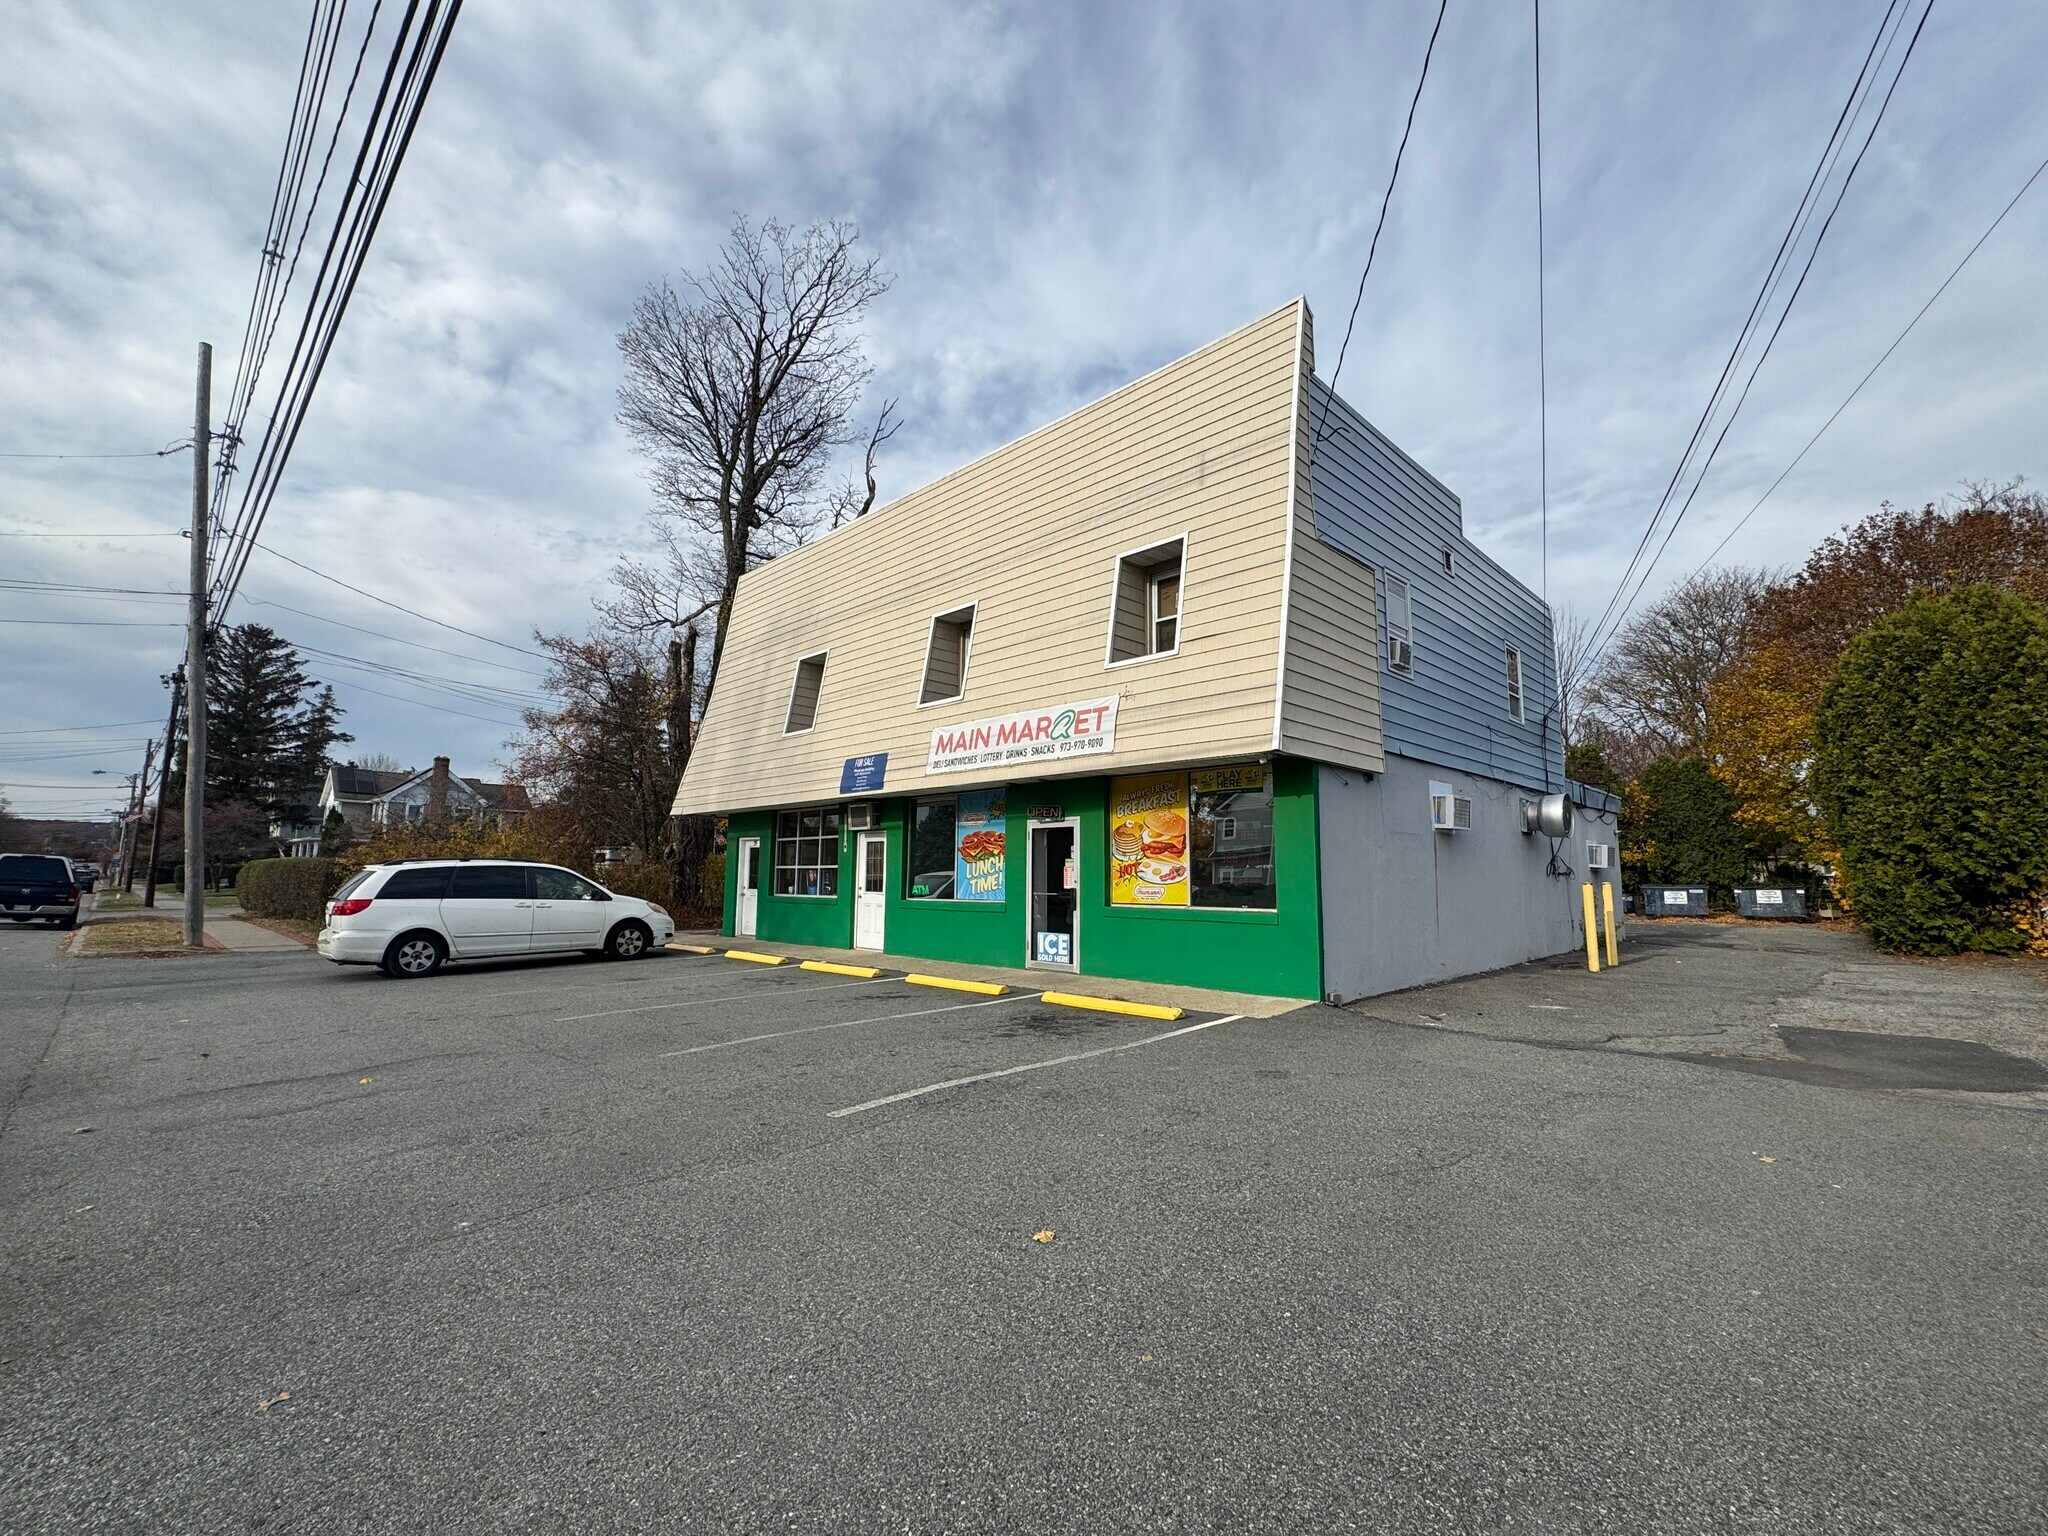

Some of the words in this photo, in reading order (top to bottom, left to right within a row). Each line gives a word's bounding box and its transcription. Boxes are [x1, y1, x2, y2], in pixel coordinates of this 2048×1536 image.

[935, 726, 992, 755] MAIN
[863, 756, 875, 766] SALE
[932, 760, 944, 769] DELI
[944, 755, 978, 768] SANDWICHES
[980, 751, 1003, 762] LOTTERY
[1005, 747, 1028, 759] DRINKS
[1031, 744, 1056, 756] SNACKS
[1060, 737, 1104, 752] 973-970-9090
[1216, 770, 1242, 780] PLAY
[1216, 779, 1242, 788] HERE
[1122, 786, 1151, 803] ALWAYS
[1150, 781, 1173, 795] FRESH
[1027, 807, 1059, 817] OPEN
[1116, 789, 1182, 818] BREAKFAST
[966, 855, 1004, 878] LUNCH
[1119, 862, 1141, 878] HOT
[912, 885, 930, 895] ATM
[970, 872, 1002, 895] TIME!
[1038, 935, 1068, 955] ICE
[1038, 954, 1053, 962] SOLD
[1054, 955, 1070, 963] HERE
